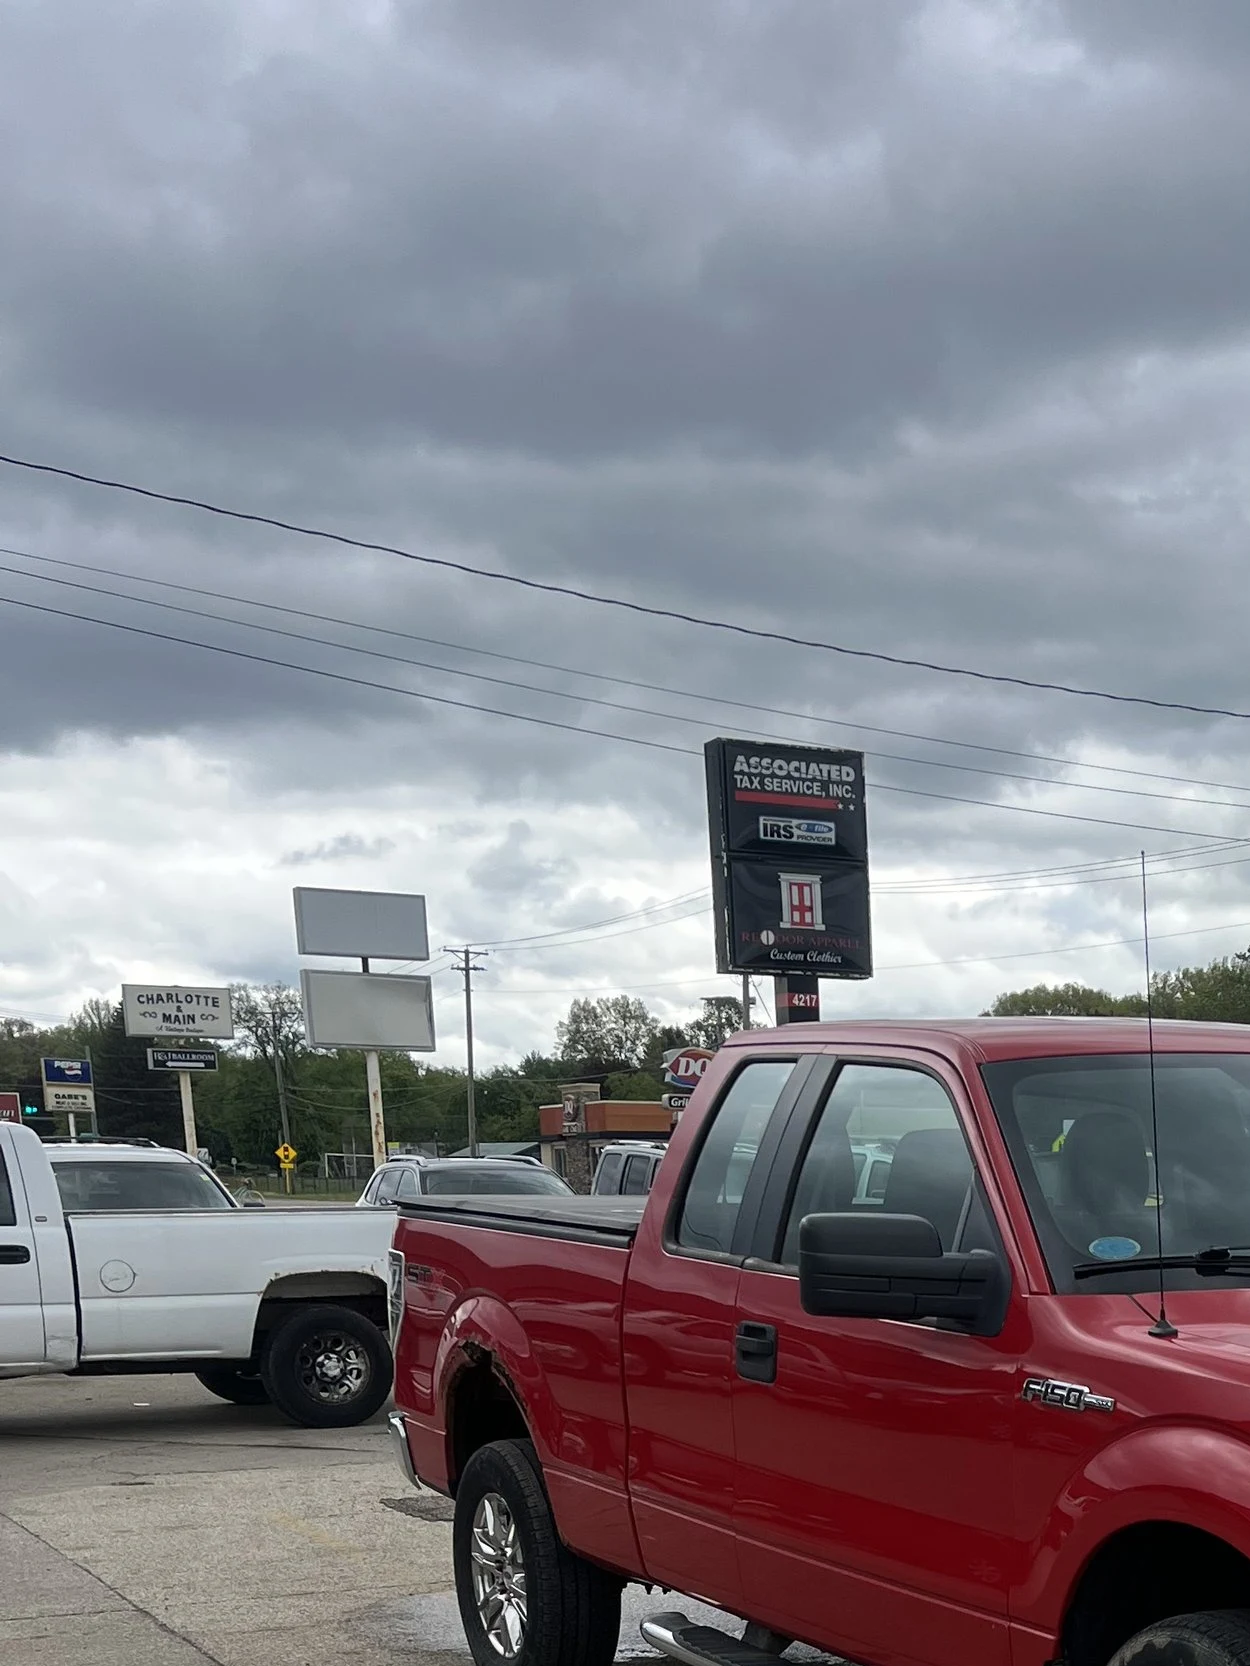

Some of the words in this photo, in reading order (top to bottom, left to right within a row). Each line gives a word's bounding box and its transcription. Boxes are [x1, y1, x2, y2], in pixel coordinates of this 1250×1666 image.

[733, 755, 856, 782] ASSOCIATED
[733, 775, 761, 790] TAX
[763, 777, 826, 798] SERVICE,
[829, 784, 856, 799] INC.
[762, 822, 795, 840] IRS
[770, 947, 805, 961] Custom
[137, 992, 220, 1008] CHARLOTTE
[792, 993, 818, 1007] 4217
[176, 1005, 183, 1013] &
[162, 1012, 196, 1025] MAIN
[171, 1052, 215, 1062] BALLROOM
